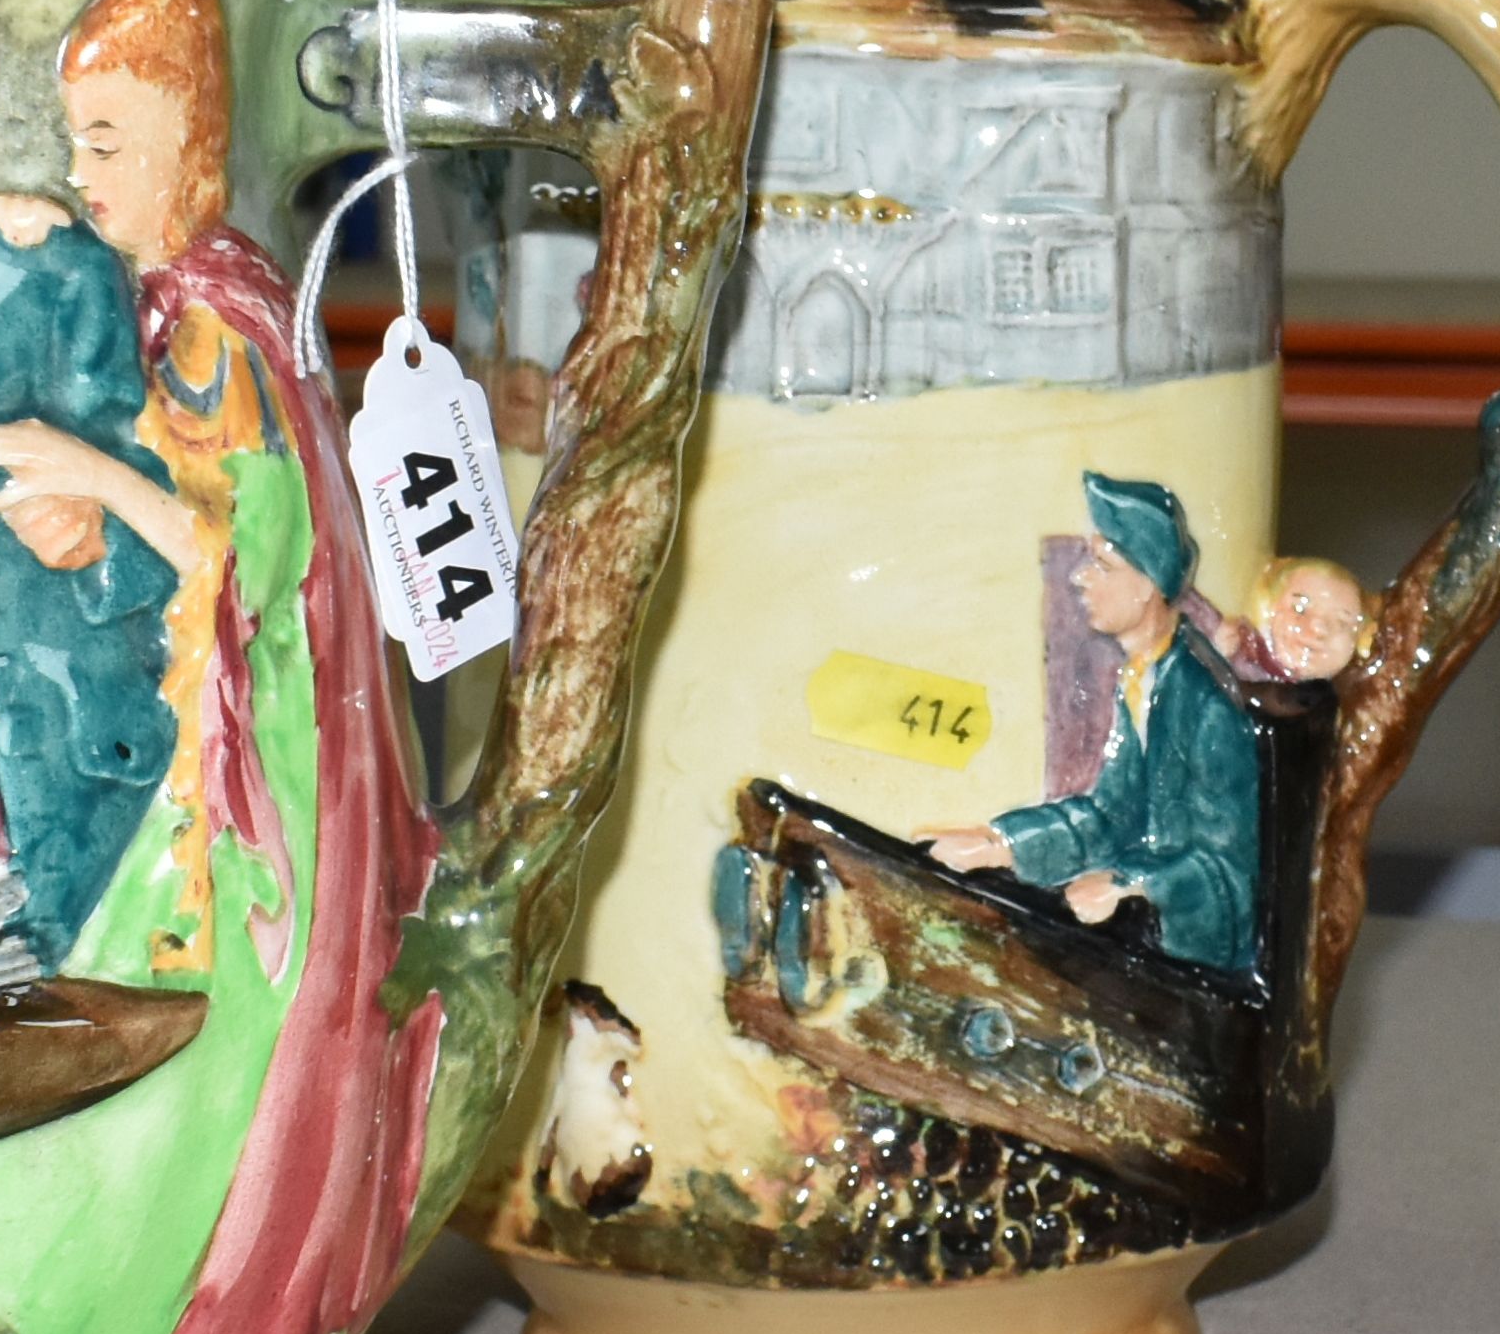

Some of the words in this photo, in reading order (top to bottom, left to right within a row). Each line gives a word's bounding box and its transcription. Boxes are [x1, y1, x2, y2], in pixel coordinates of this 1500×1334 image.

[448, 398, 484, 493] RICHARD
[372, 486, 427, 628] AUCTIONEERS
[400, 451, 494, 624] 414
[899, 694, 973, 744] 414
